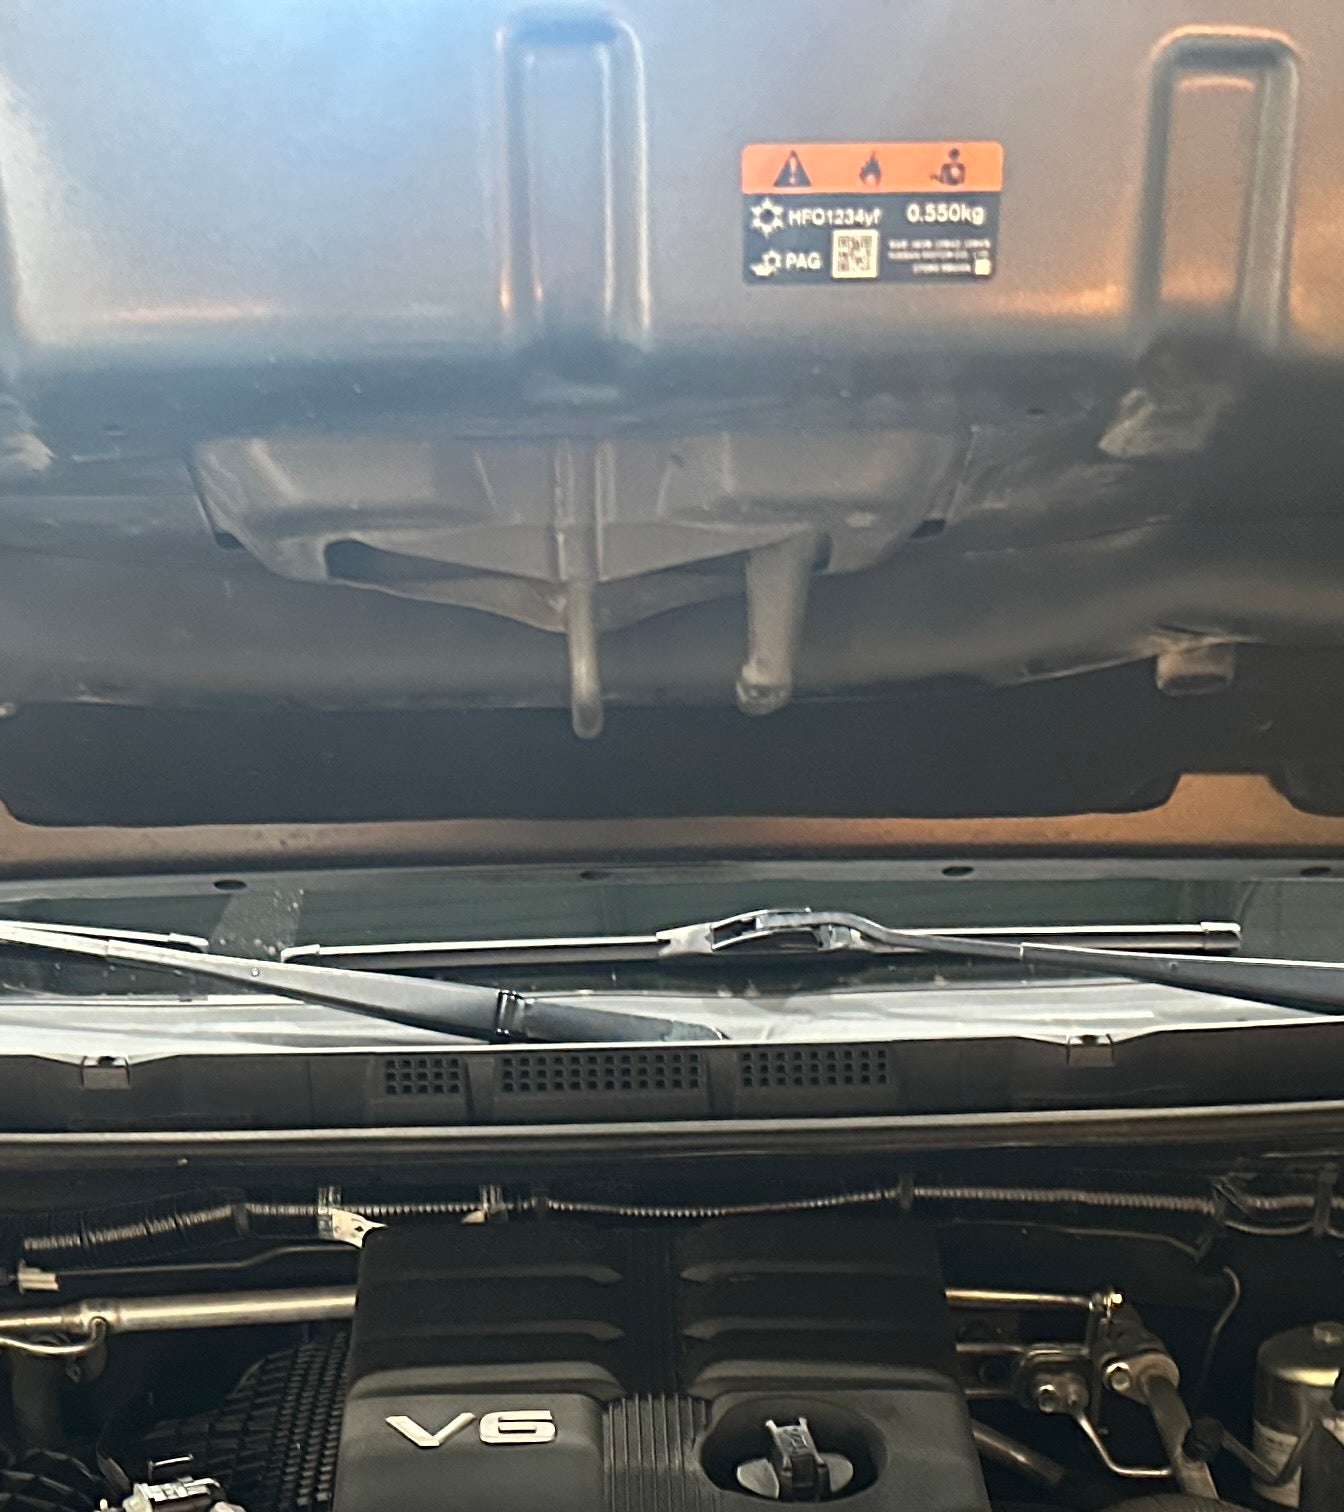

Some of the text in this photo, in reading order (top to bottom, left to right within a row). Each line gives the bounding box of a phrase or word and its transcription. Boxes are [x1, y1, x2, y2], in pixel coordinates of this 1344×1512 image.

[787, 208, 881, 226] HFO1234yf
[906, 202, 984, 225] 0.550kg
[785, 252, 821, 270] PAG
[385, 1409, 557, 1448] V6
